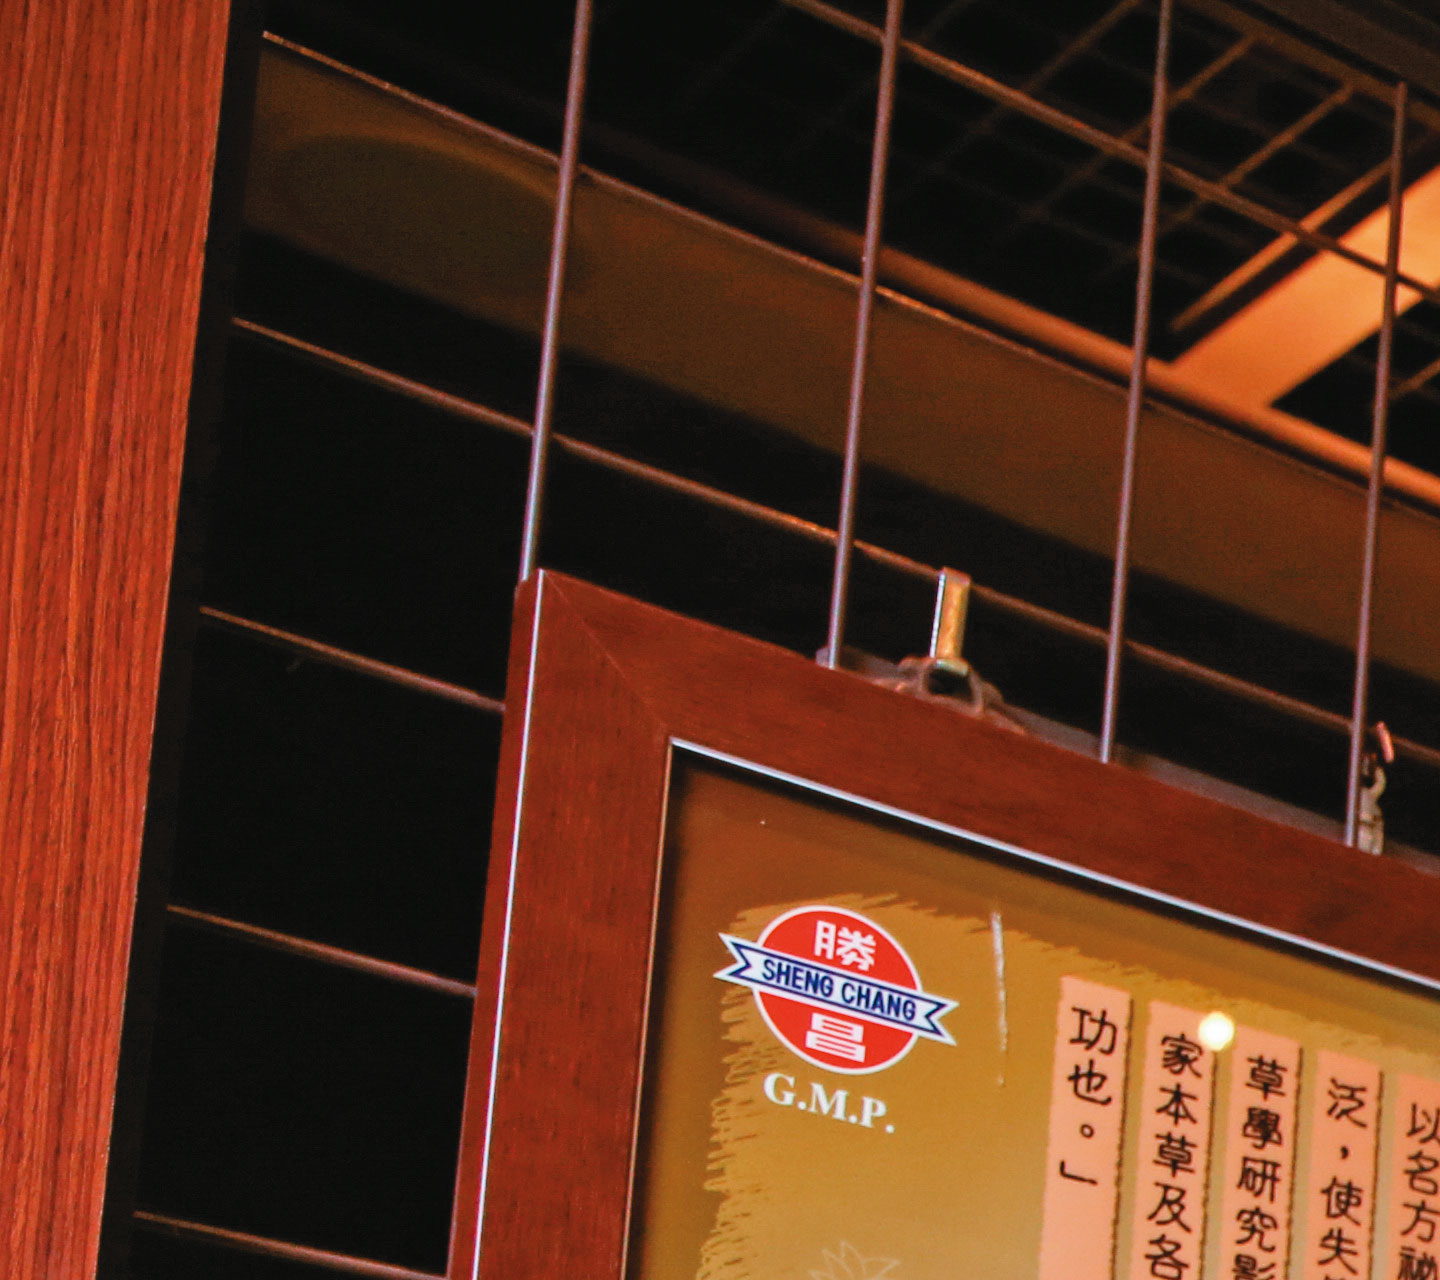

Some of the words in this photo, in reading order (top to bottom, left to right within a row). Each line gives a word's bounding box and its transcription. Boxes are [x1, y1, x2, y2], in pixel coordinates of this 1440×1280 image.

[814, 920, 876, 971] 勝
[761, 958, 834, 998] SHENG
[841, 982, 917, 1021] CHANG
[805, 1012, 866, 1063] 昌
[763, 1072, 895, 1134] G.M.P.
